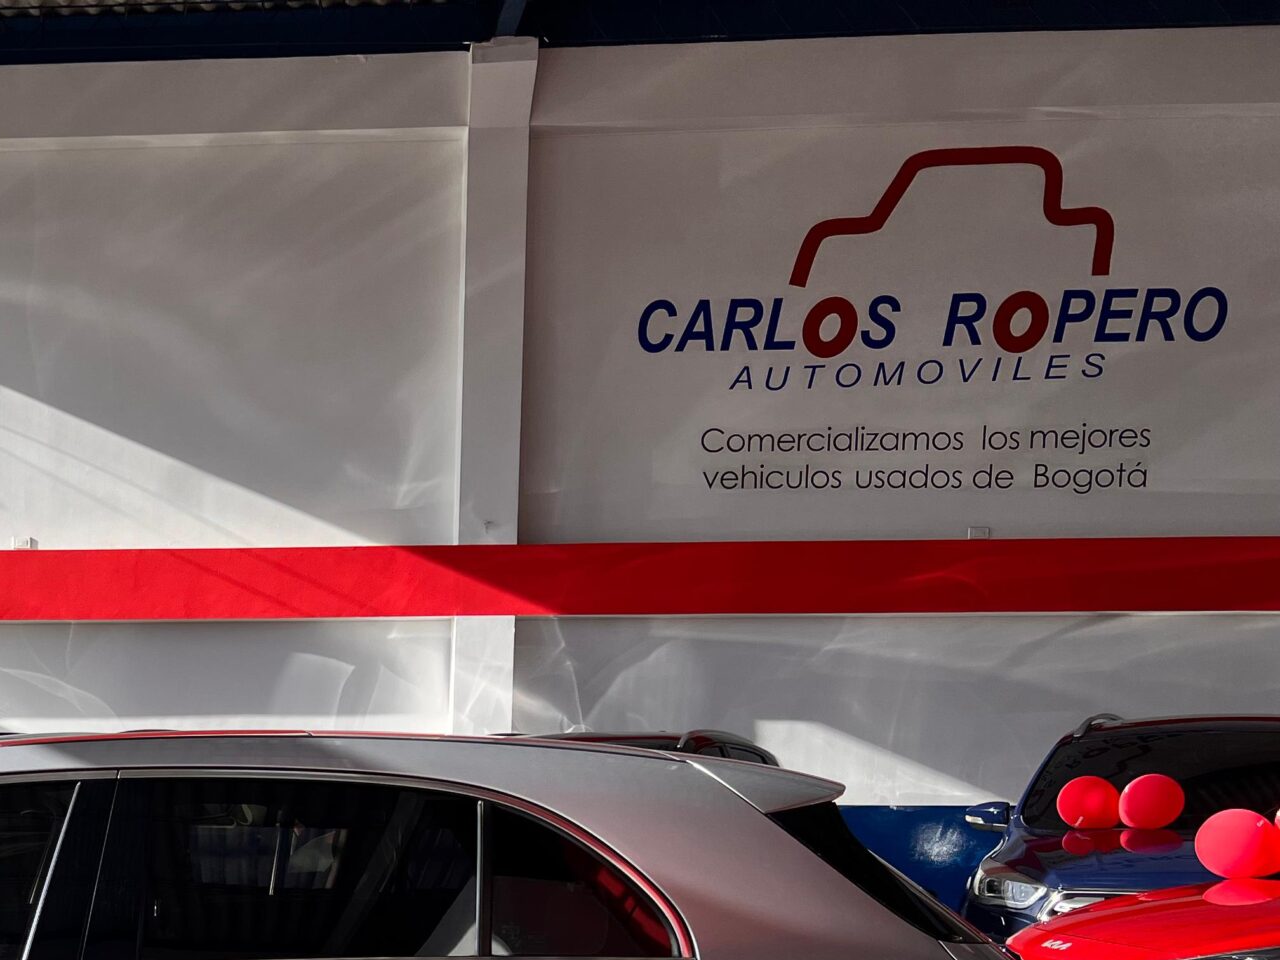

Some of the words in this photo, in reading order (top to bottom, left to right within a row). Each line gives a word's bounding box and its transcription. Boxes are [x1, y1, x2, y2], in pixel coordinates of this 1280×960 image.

[637, 294, 901, 358] CARLOS
[942, 286, 1228, 354] ROPERO
[729, 352, 1106, 391] AUTOMOVILES
[701, 426, 964, 453] Comercializamos
[982, 425, 1020, 451] los
[1030, 422, 1151, 455] mejores
[703, 464, 842, 489] vehiculos
[855, 463, 962, 489] usados
[972, 463, 1014, 489] de
[1034, 461, 1148, 494] Bogotá
